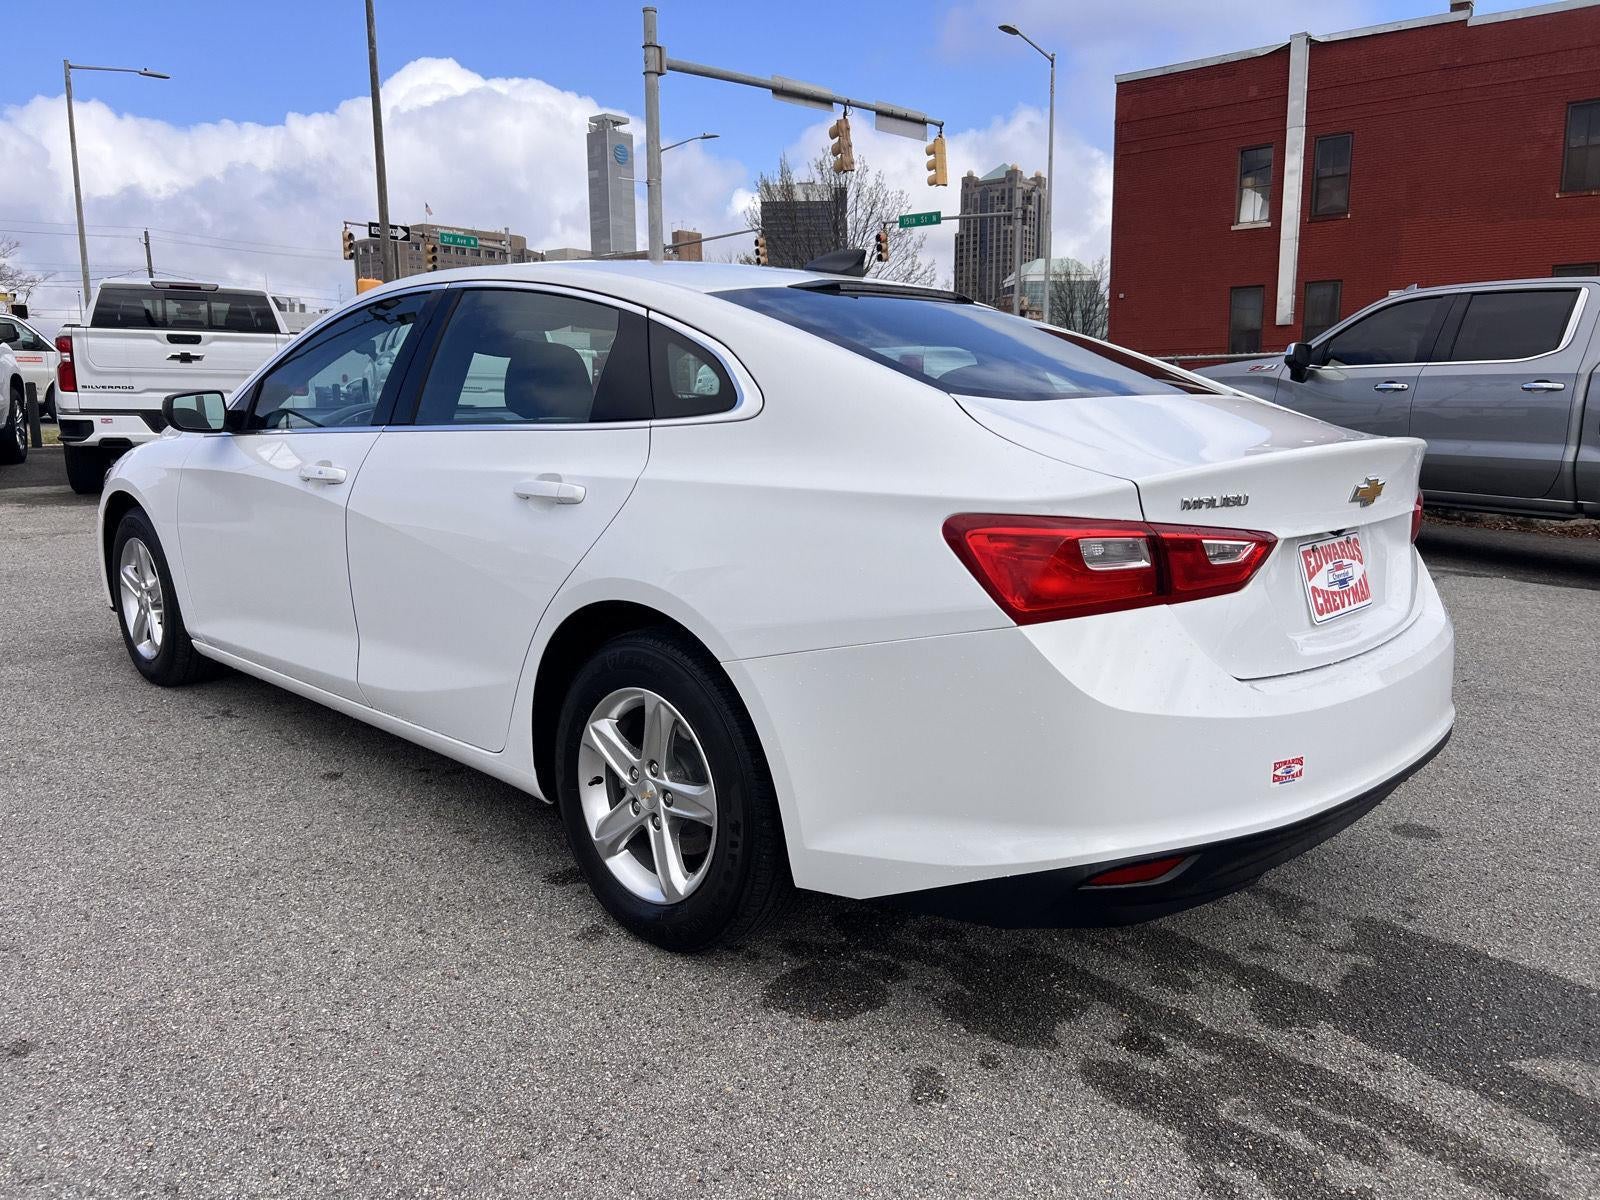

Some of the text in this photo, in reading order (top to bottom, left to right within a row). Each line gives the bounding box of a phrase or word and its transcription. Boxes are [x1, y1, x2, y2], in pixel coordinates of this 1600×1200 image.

[920, 215, 927, 223] St
[443, 235, 453, 243] 3rd
[457, 237, 466, 245] Ave
[1180, 495, 1249, 511] MALIBU
[1301, 537, 1364, 582] EDWARDS
[1311, 569, 1371, 617] CHEVYMAN
